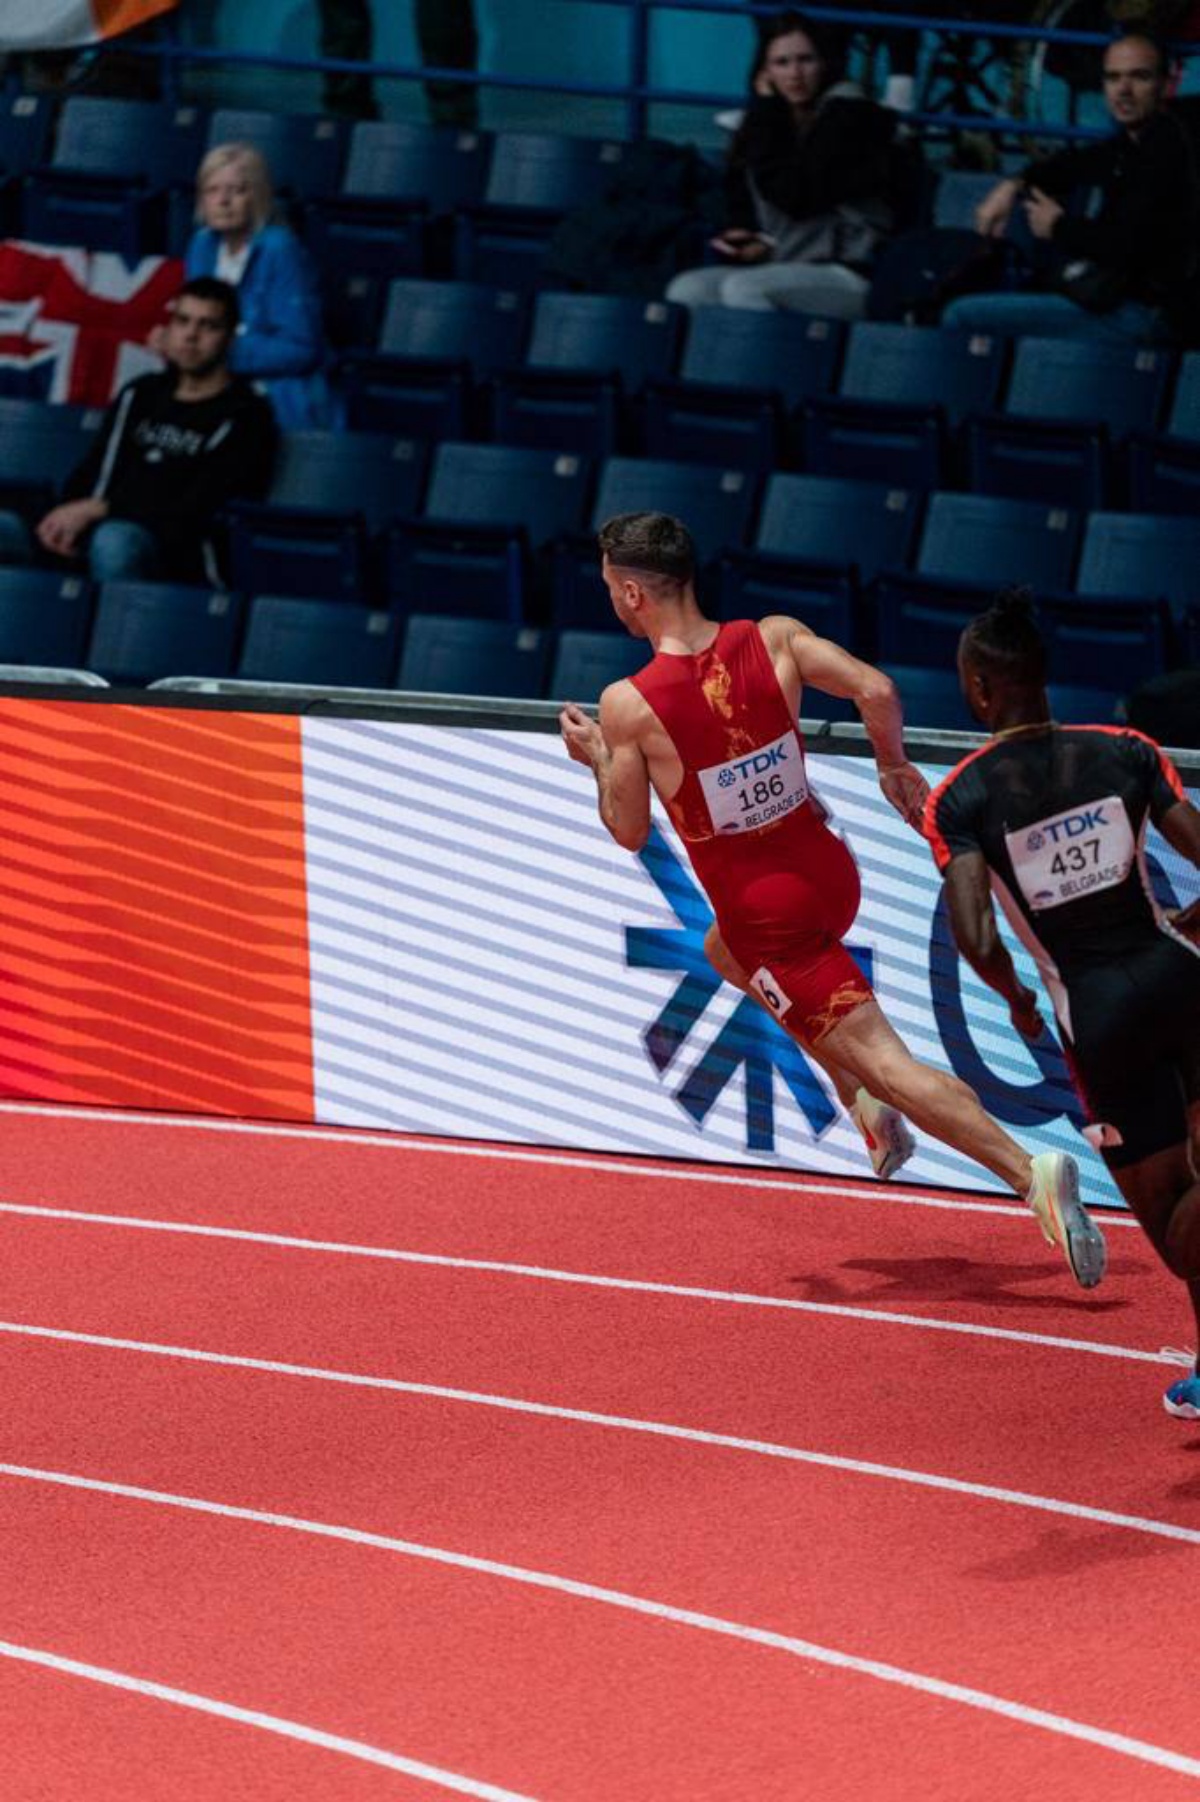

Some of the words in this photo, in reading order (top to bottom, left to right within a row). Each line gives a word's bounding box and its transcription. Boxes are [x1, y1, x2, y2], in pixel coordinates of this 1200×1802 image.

[733, 743, 788, 780] TDK
[738, 773, 784, 812] 186
[745, 794, 794, 828] BELGRADE
[1042, 806, 1109, 842] TDK
[1051, 838, 1101, 876] 437
[1059, 865, 1120, 897] BELGRADE
[758, 979, 780, 1009] 6
